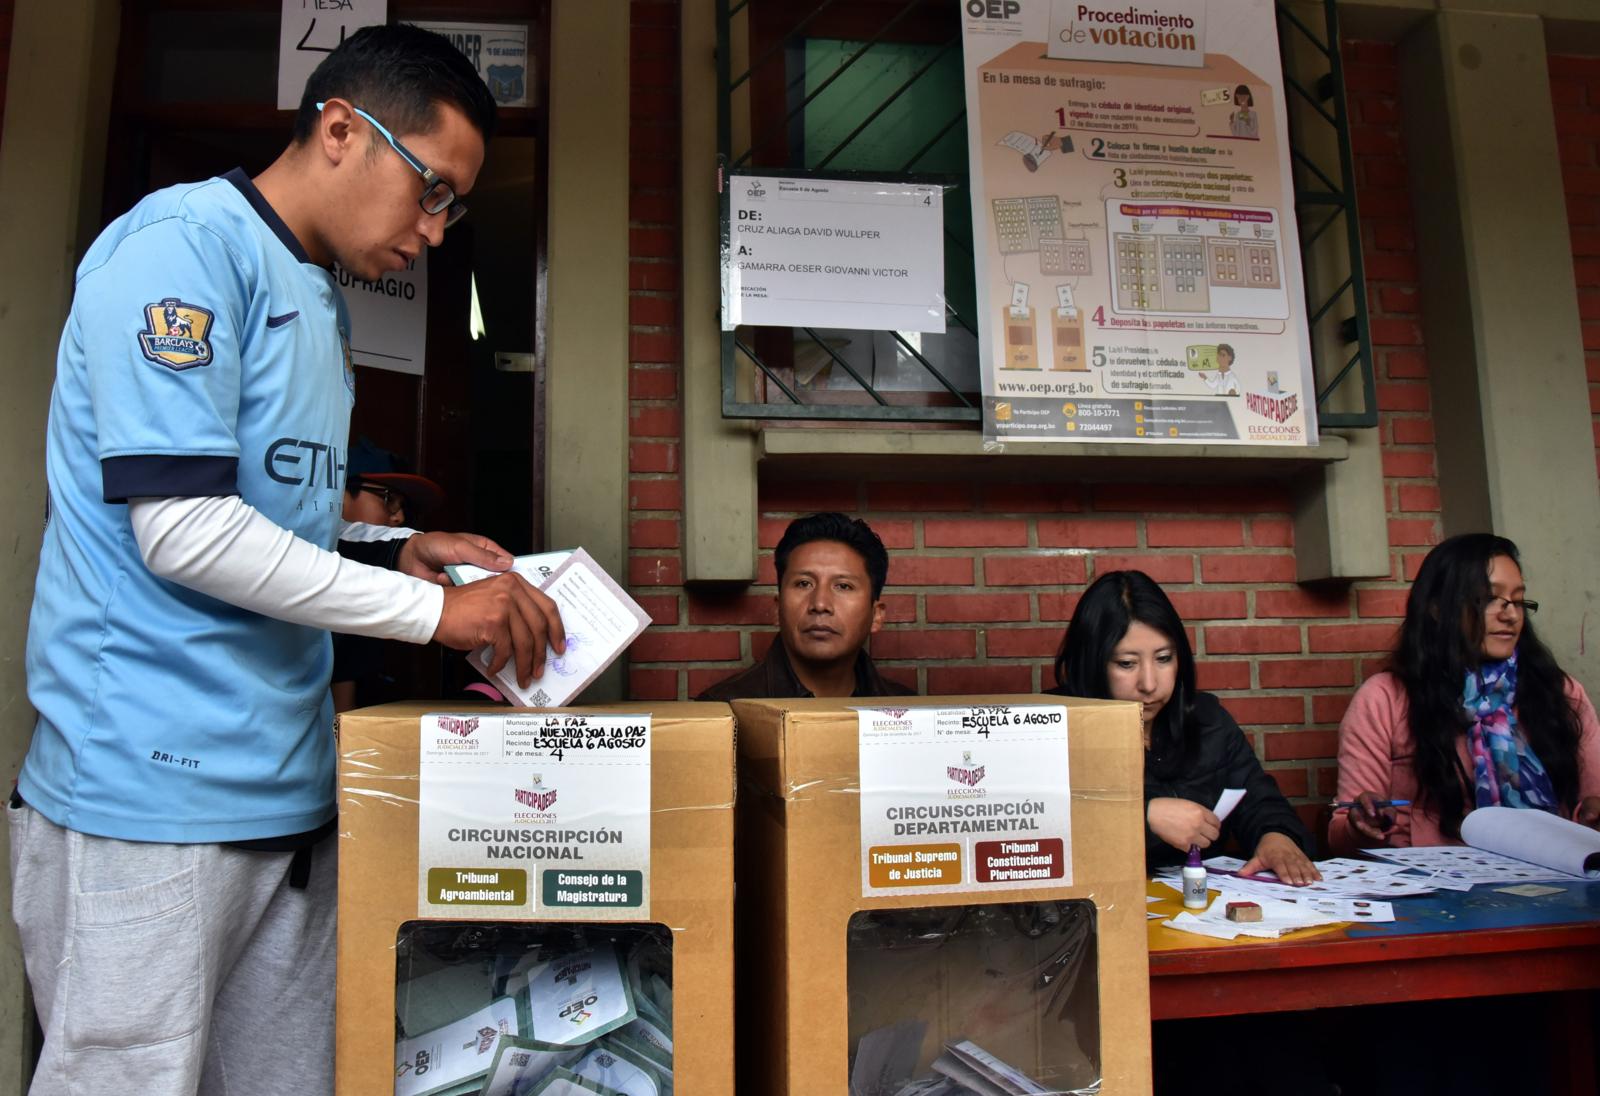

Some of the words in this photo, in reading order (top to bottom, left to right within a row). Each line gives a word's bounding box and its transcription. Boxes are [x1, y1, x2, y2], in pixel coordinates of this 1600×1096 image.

[966, 0, 1020, 19] OEP
[1077, 4, 1194, 29] Procedimiento
[1060, 20, 1086, 44] de
[1088, 25, 1196, 50] votación
[982, 72, 996, 84] En
[1000, 72, 1010, 84] la
[1013, 75, 1041, 86] mesa
[1044, 74, 1056, 87] de
[1060, 76, 1106, 92] sufragio:
[1055, 107, 1066, 126] 1
[1091, 138, 1106, 158] 2
[1113, 168, 1128, 188] 3
[747, 189, 766, 197] OEP
[923, 195, 931, 207] 4
[738, 210, 762, 221] DE:
[738, 225, 764, 234] CRUZ
[766, 226, 801, 236] ALIAGA
[804, 227, 832, 237] DAVID
[835, 228, 880, 239] WULLPER
[738, 246, 752, 256] A:
[738, 262, 786, 272] GAMARRA
[788, 263, 822, 274] OESER
[825, 264, 870, 276] GIOVANNI
[873, 266, 908, 277] VICTOR
[1092, 305, 1106, 327] 4
[1110, 317, 1140, 328] Deposita
[1152, 319, 1185, 330] papeletas
[154, 337, 194, 348] BARCLAYS
[1092, 346, 1107, 367] 5
[1116, 357, 1146, 366] devuelve
[1156, 356, 1178, 366] cédula
[998, 382, 1094, 394] www.oep.org.bo
[1121, 382, 1149, 391] sufragio
[1248, 425, 1300, 434] ELECCIONES
[545, 718, 559, 726] LA
[565, 718, 587, 726] PAZ
[962, 716, 1009, 728] ESCUELA
[1014, 714, 1021, 725] 6
[1023, 713, 1061, 725] AGOSTO
[611, 727, 623, 737] LA
[625, 726, 646, 737] PAZ
[977, 726, 990, 739] 4
[534, 738, 583, 749] ESCUELA
[586, 738, 595, 749] 6
[597, 738, 645, 749] AGOSTO
[151, 750, 200, 768] DRI-FIT
[550, 749, 563, 761] 4
[514, 788, 557, 811] PARTICIPADECIDE
[886, 799, 1045, 820] CIRCUNSCRIPCIÓN
[894, 818, 1039, 835] DEPARTAMENTAL
[448, 827, 623, 844] CIRCUNSCRIPCIÓN
[487, 846, 584, 860] NACIONAL
[1000, 842, 1039, 853] Tribunal
[872, 853, 912, 864] Tribunal
[915, 852, 958, 864] Supremo
[987, 854, 1052, 867] Constitucional
[456, 872, 499, 884] Tribunal
[558, 874, 598, 887] Consejo
[601, 874, 614, 886] de
[617, 874, 627, 886] la
[889, 870, 900, 880] de
[904, 868, 942, 879] Justicia
[990, 867, 1050, 880] Plurinacional
[440, 888, 514, 902] Agroambiental
[557, 890, 628, 904] Magistratura
[559, 996, 598, 1018] OEP
[415, 1050, 430, 1075] OEP
